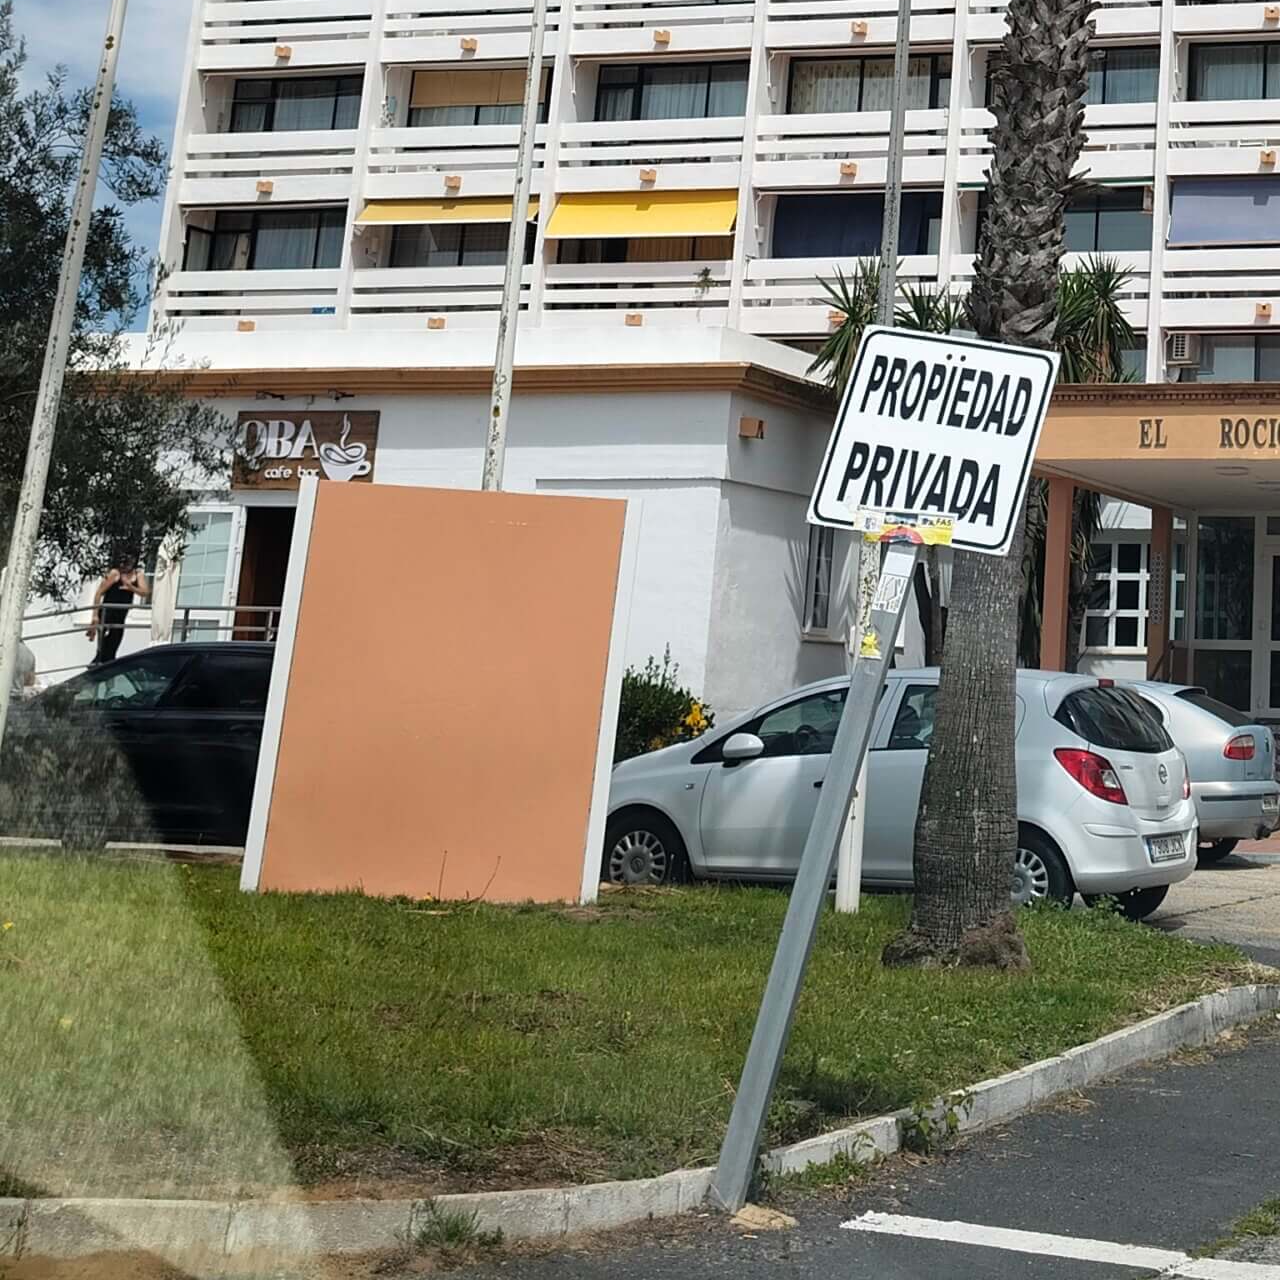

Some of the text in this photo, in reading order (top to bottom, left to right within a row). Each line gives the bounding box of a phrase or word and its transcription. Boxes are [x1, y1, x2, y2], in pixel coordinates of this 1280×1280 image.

[859, 355, 1033, 437] PROPIEDAD
[1139, 418, 1168, 449] EL
[264, 465, 293, 478] cafe
[837, 441, 1002, 527] PRIVADA
